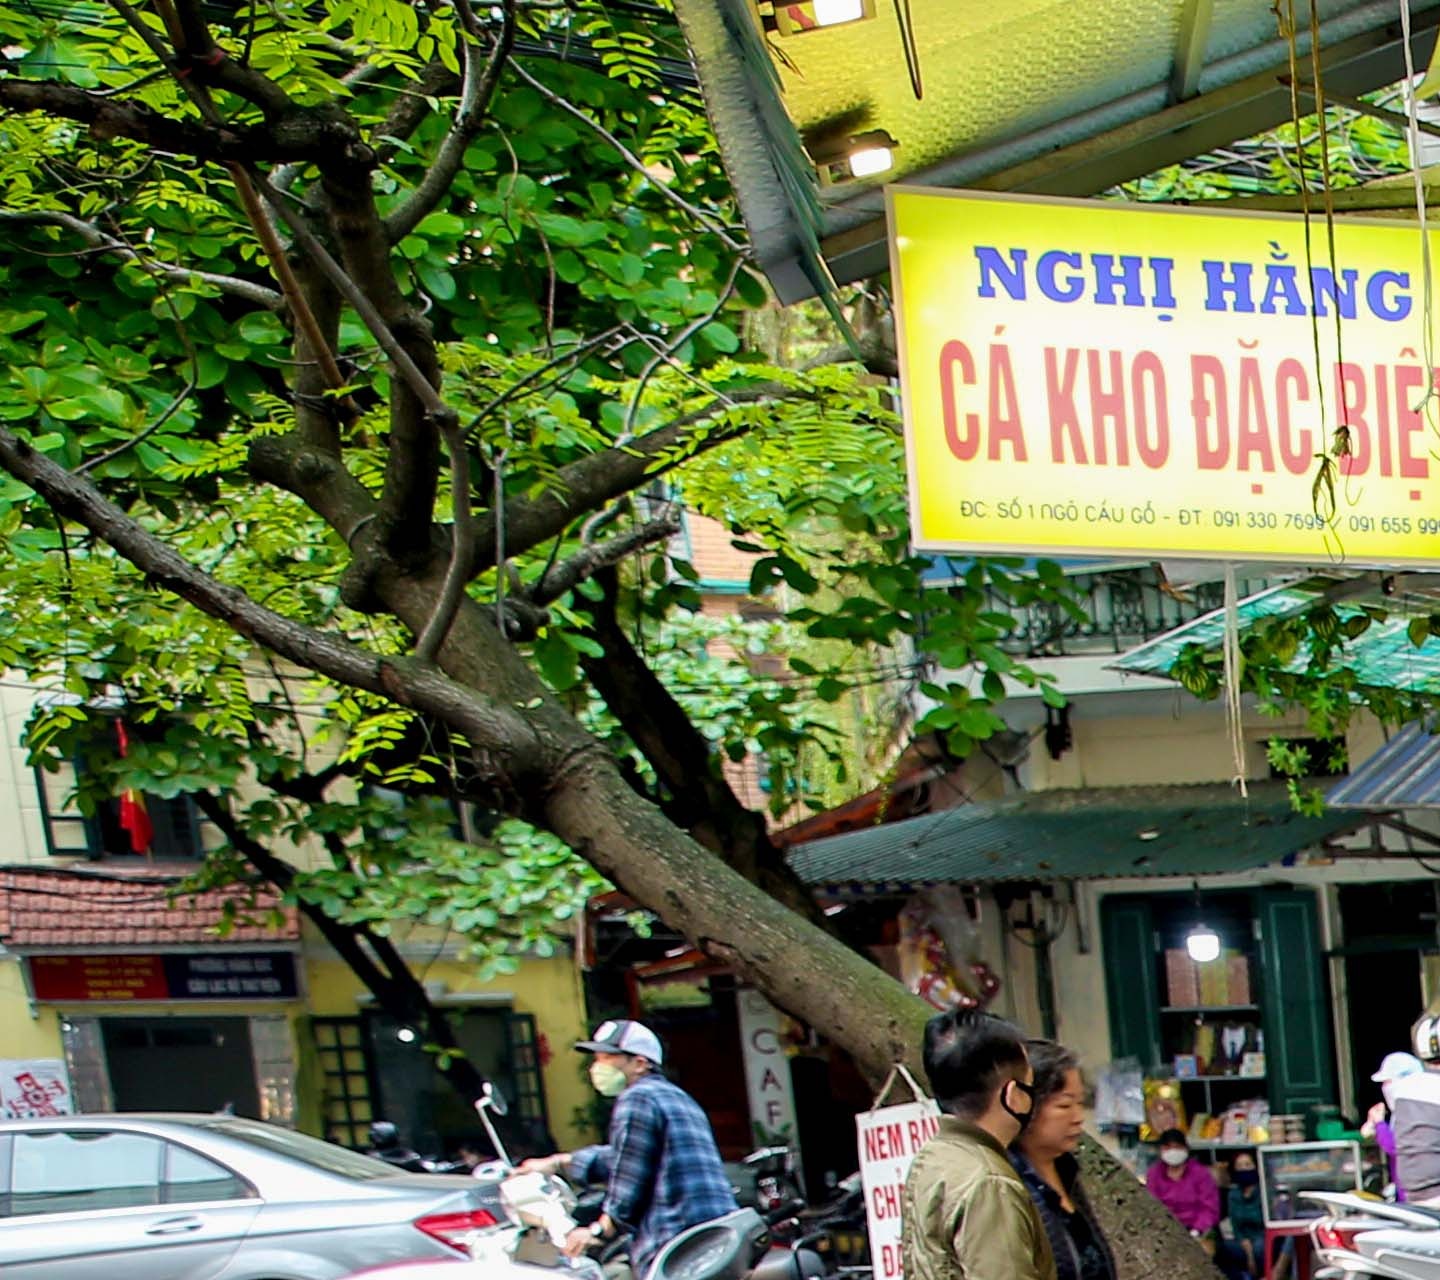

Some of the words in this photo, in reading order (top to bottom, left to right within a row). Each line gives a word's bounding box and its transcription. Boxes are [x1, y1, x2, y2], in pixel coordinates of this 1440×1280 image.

[973, 245, 1178, 323] NGHỊ
[1200, 240, 1413, 322] HẰNG
[938, 325, 1029, 464] CÁ
[1043, 345, 1171, 470] KHO
[1189, 338, 1316, 496] ĐẶC
[1213, 511, 1241, 529] 091
[1246, 512, 1278, 531] 330
[1348, 514, 1376, 534] 091
[864, 1122, 905, 1163] NEM
